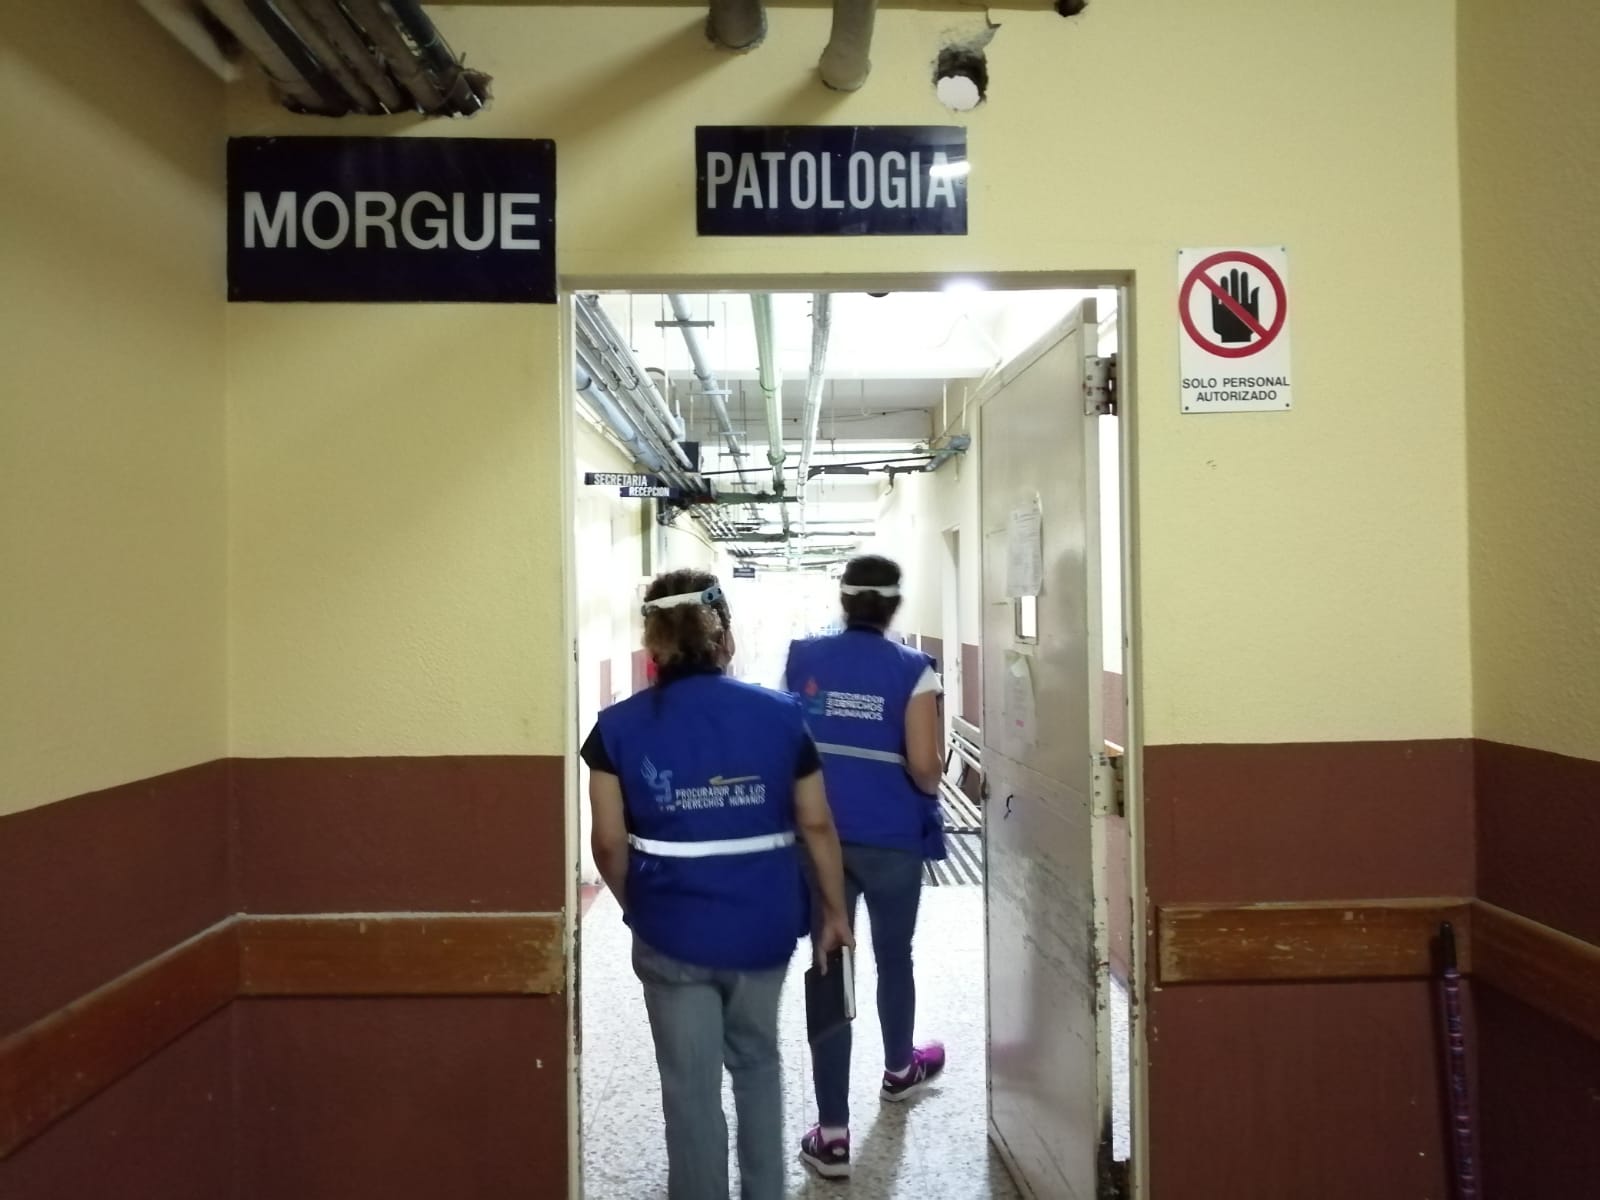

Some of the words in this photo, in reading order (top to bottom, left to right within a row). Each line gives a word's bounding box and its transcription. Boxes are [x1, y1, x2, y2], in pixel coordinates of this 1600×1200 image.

[706, 150, 957, 210] PATOLOGIA
[243, 191, 541, 251] MORGUE
[1182, 378, 1217, 389] SOLO
[1223, 376, 1290, 388] PERSONAL
[1196, 390, 1277, 402] AUTORIZADO
[594, 473, 647, 486] SECRETARIA
[675, 786, 730, 799] PROCURADOR
[735, 785, 745, 796] DE
[750, 784, 766, 795] LOS
[682, 797, 725, 810] DERECHOS
[729, 794, 766, 807] HUMANOS
